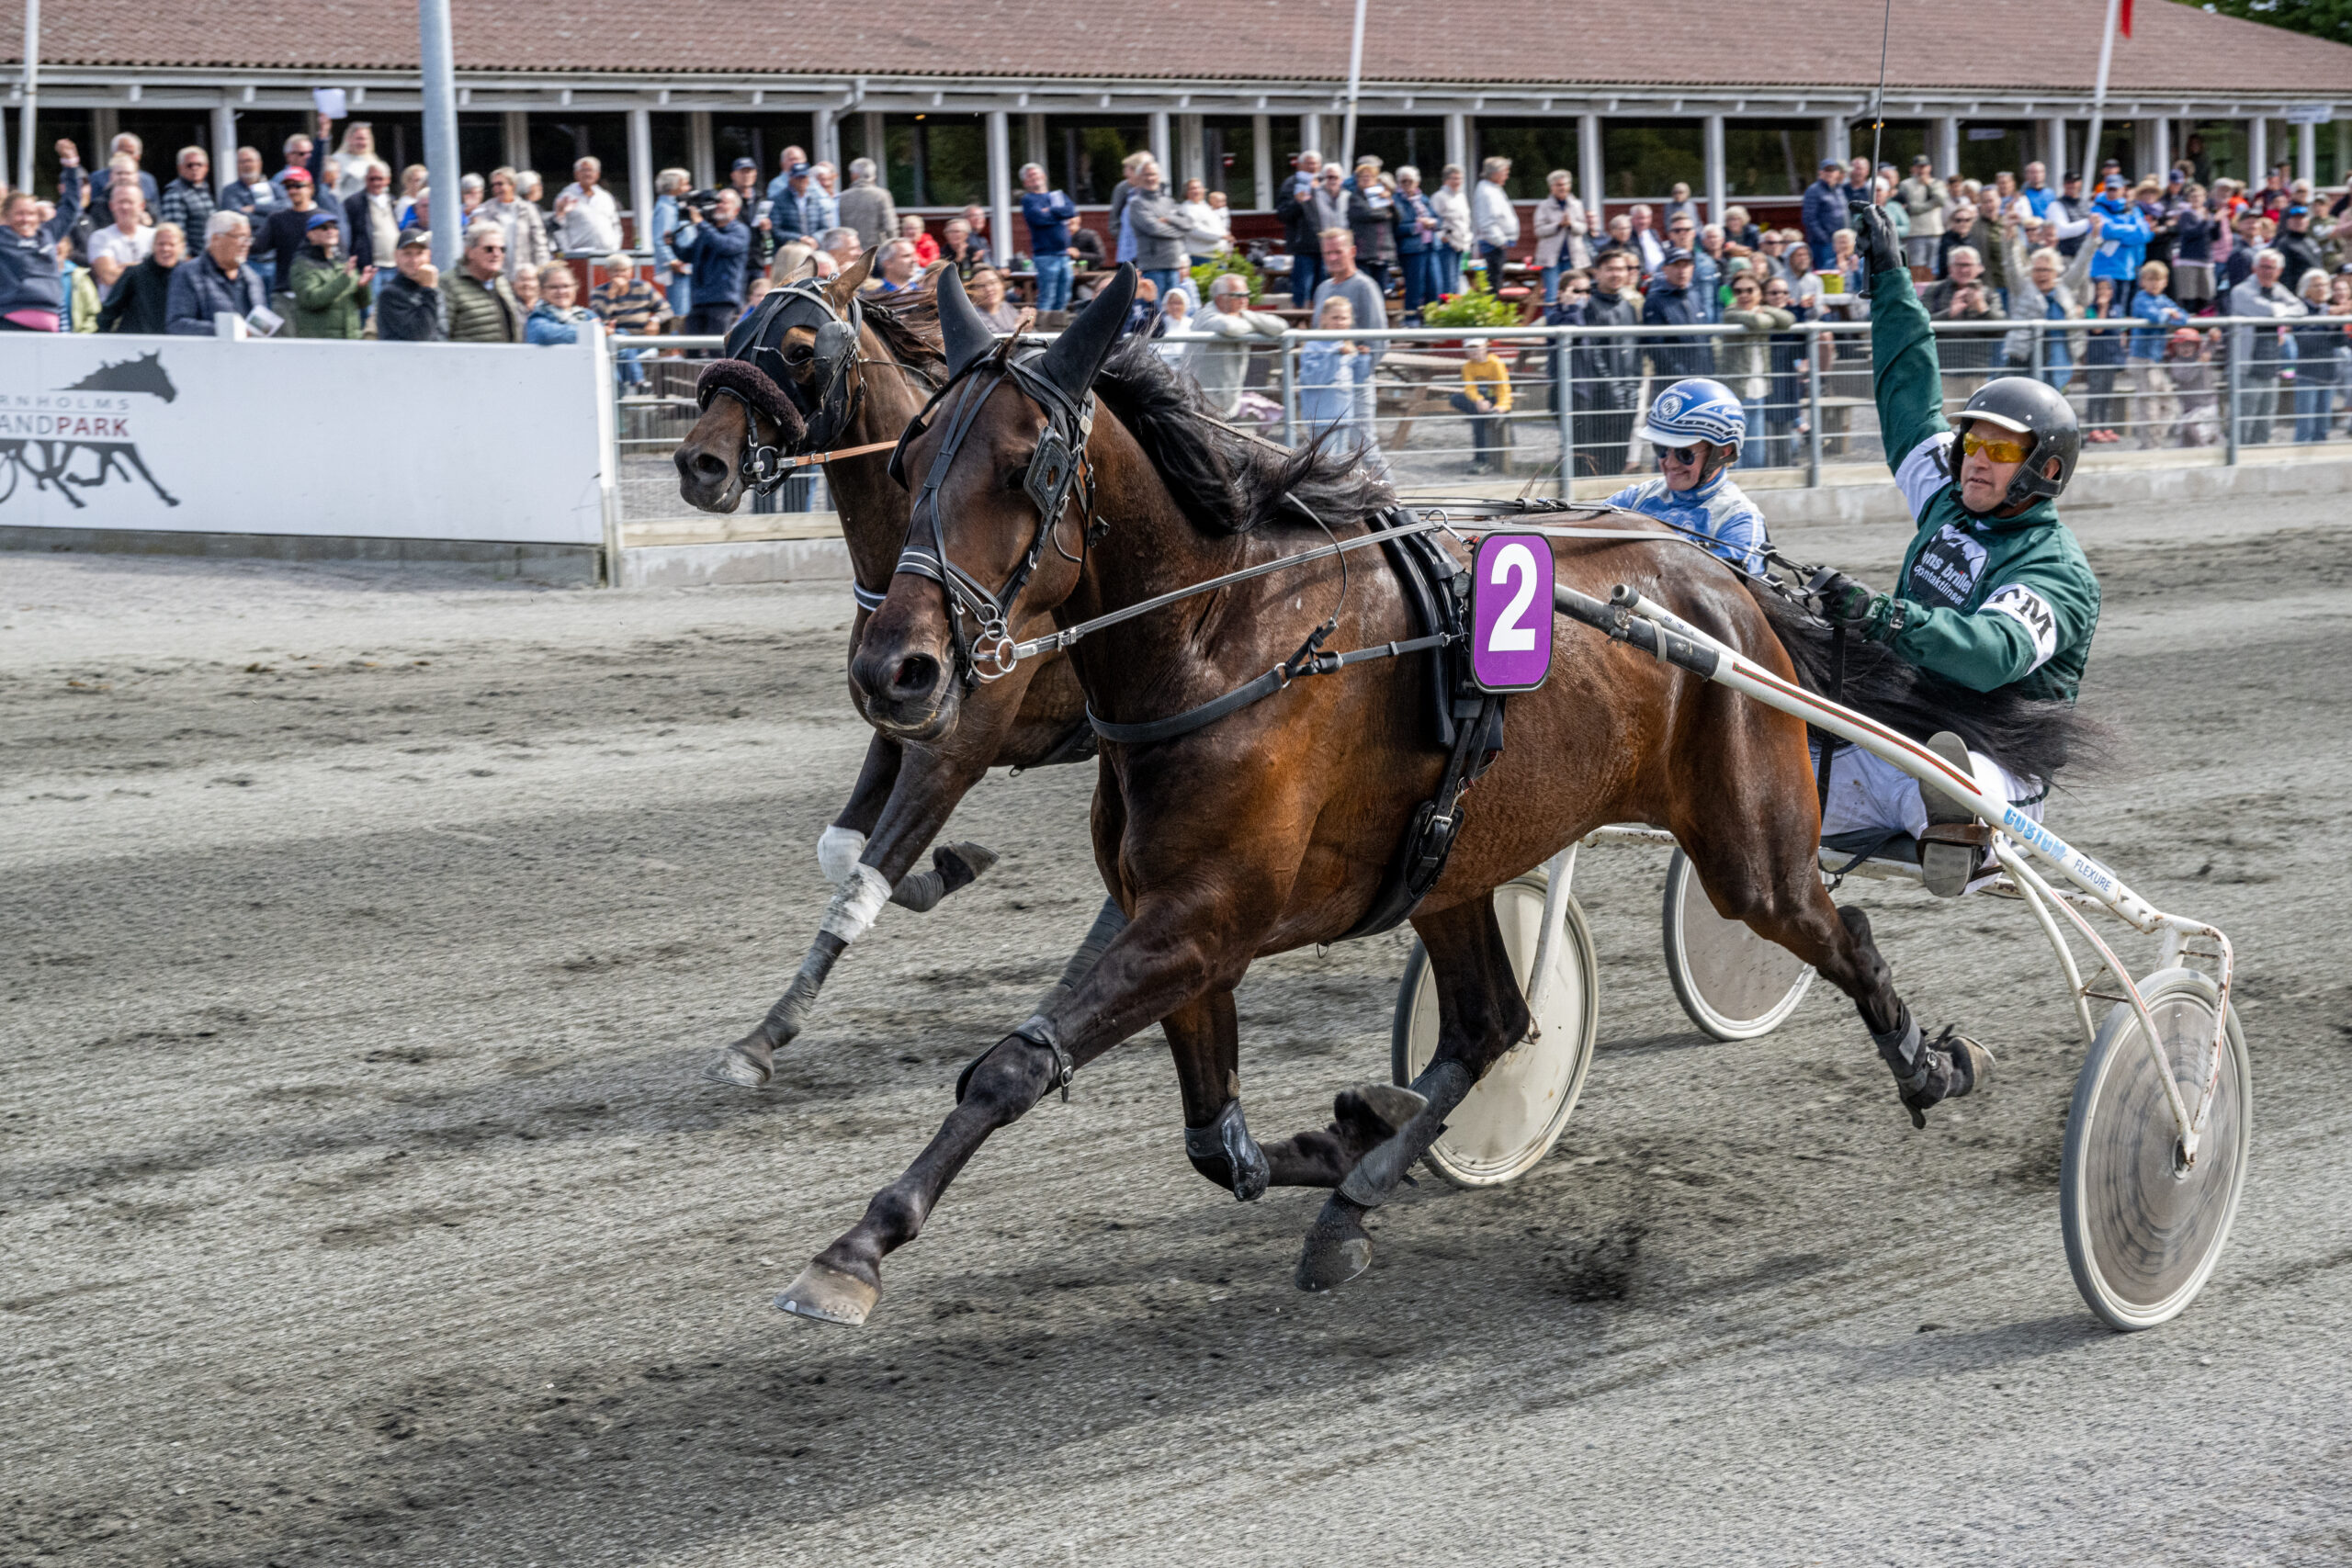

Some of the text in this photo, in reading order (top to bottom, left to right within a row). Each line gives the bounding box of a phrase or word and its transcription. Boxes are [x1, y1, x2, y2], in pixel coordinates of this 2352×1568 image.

[1488, 543, 1537, 651] 2
[2004, 807, 2112, 892] CUSTOM FLEXURE
